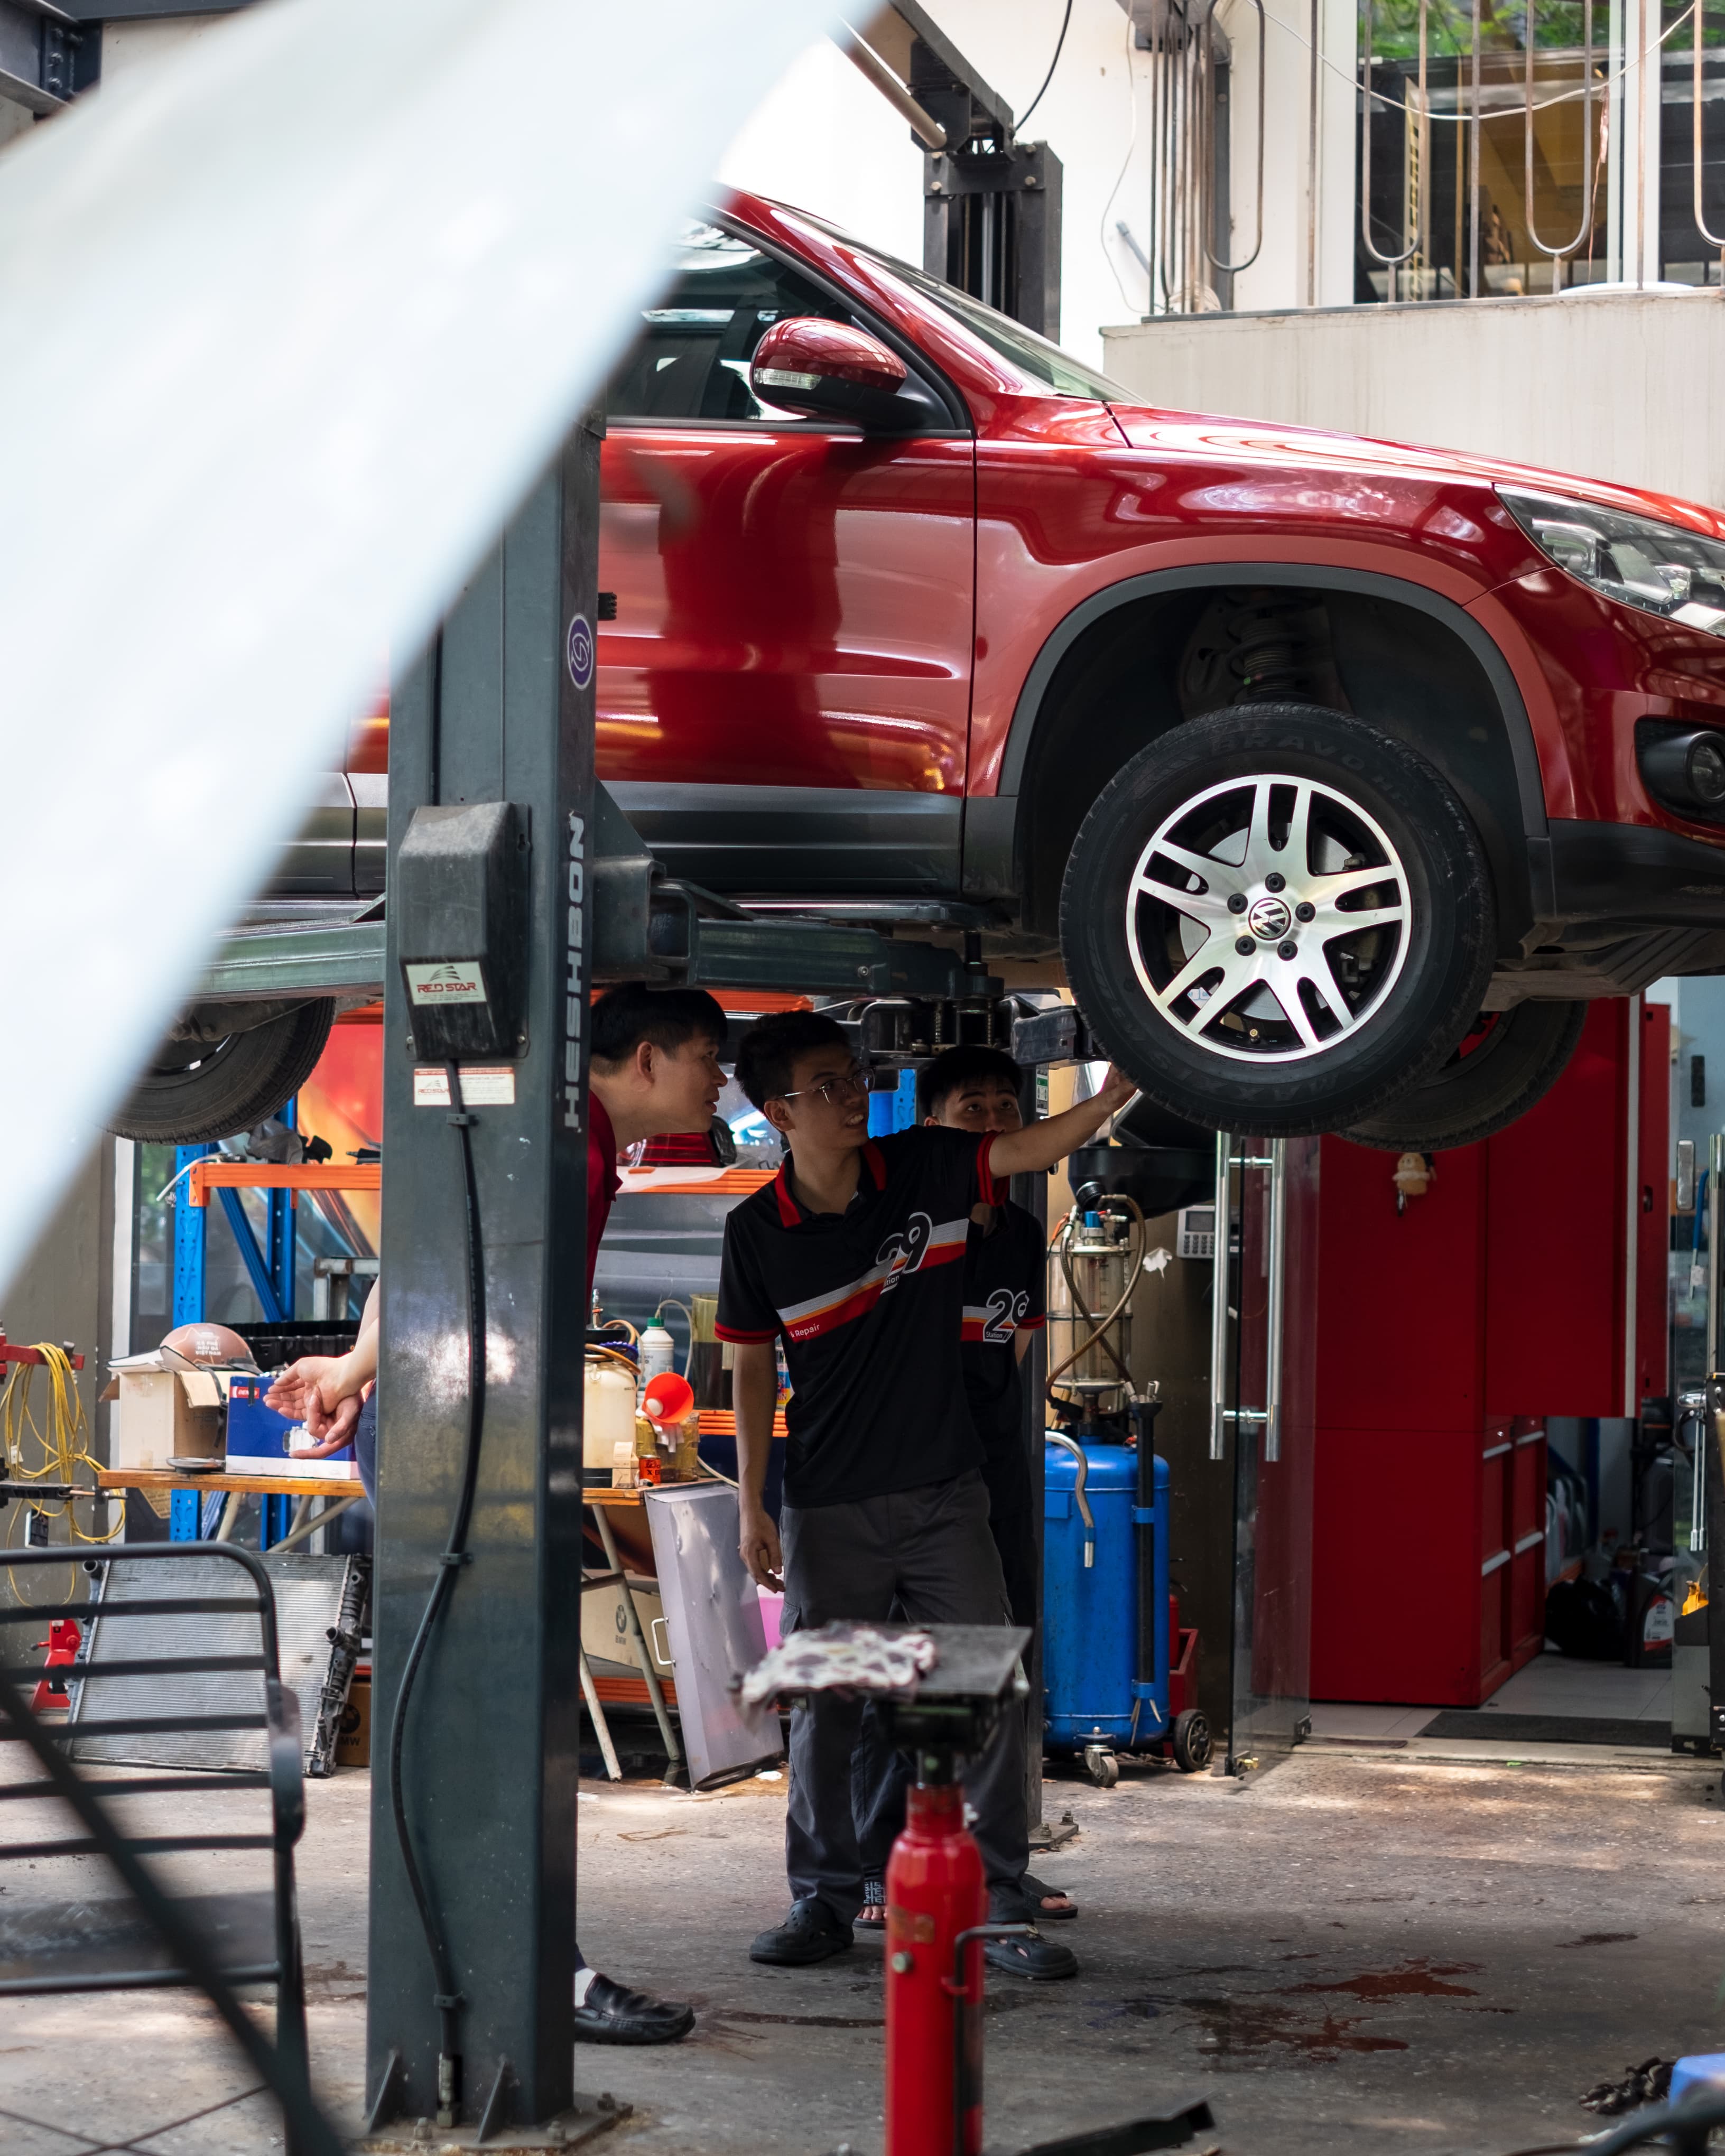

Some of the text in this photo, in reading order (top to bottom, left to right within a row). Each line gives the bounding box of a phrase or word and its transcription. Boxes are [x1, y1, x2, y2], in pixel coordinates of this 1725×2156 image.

[416, 982, 477, 993] RED STAR
[564, 815, 585, 1129] HESSHBON
[876, 1212, 933, 1294] 29
[795, 1323, 820, 1336] Repair
